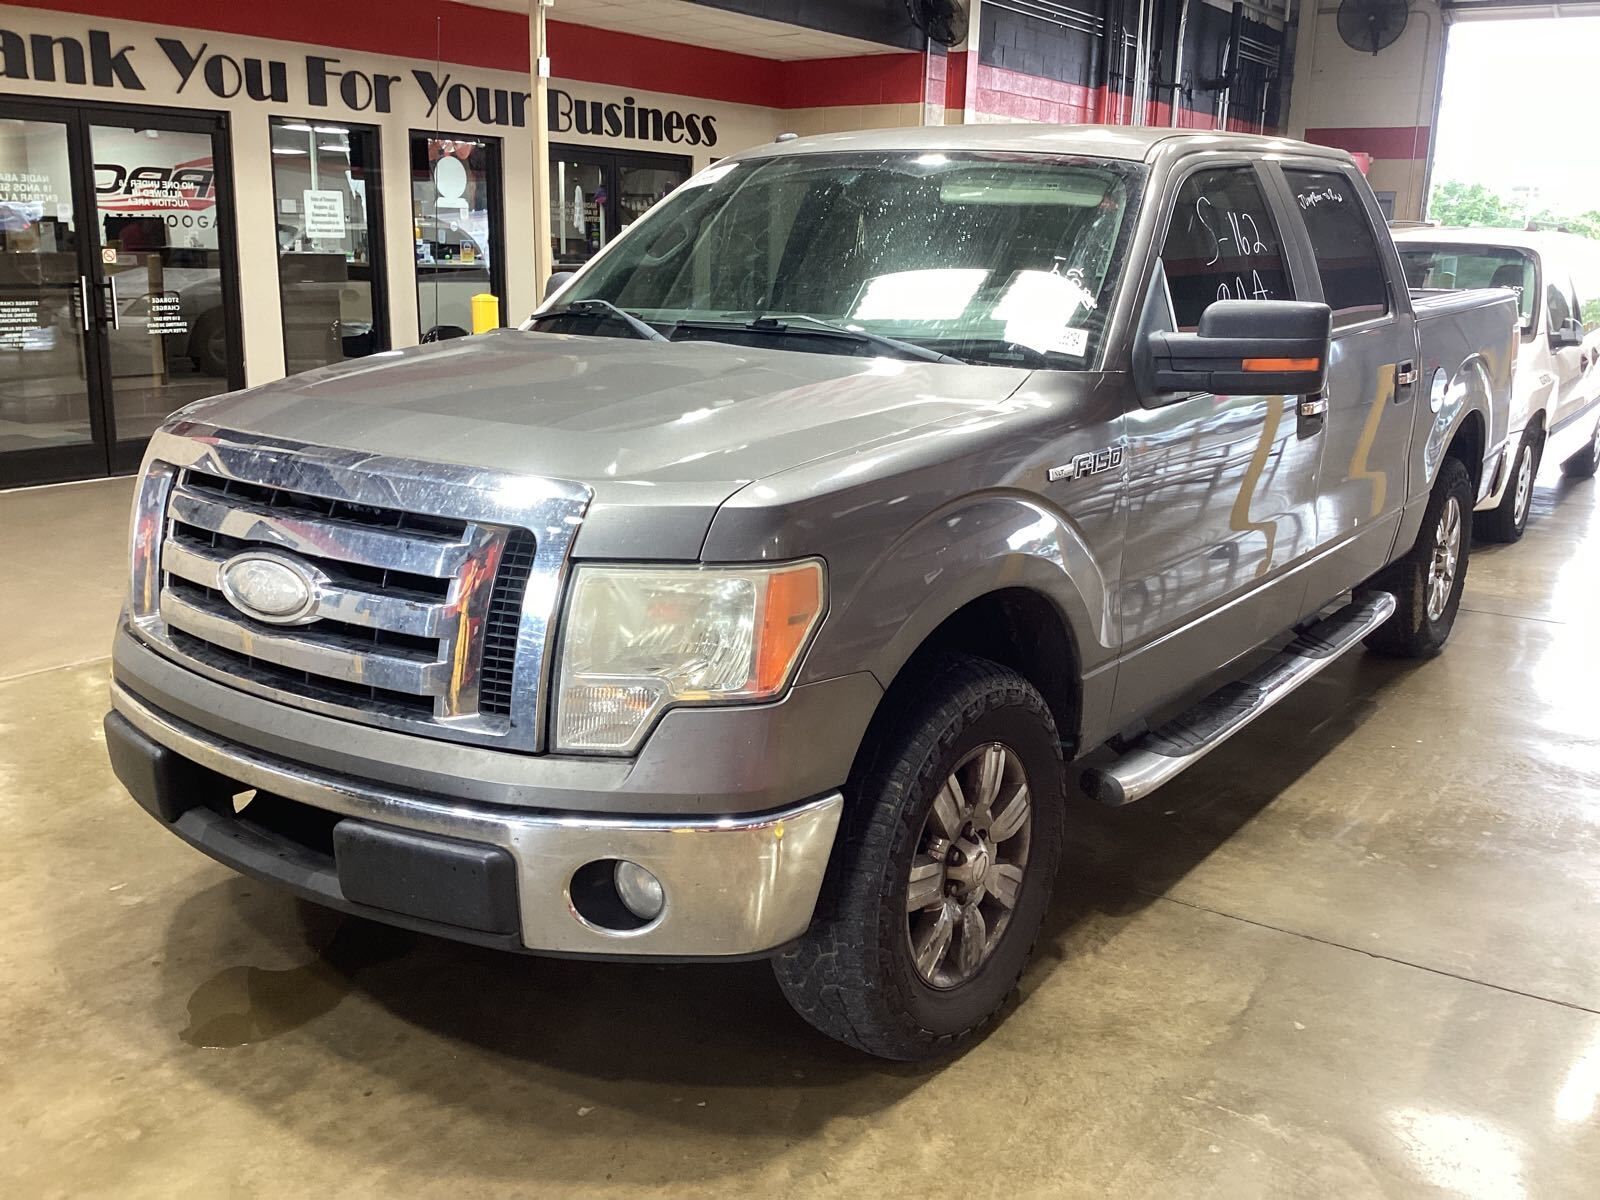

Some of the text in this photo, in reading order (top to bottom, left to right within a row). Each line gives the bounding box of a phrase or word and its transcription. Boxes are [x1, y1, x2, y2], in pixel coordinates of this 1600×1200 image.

[155, 37, 288, 103] You
[305, 55, 401, 113] For
[411, 69, 531, 127] Your
[547, 88, 717, 147] Business
